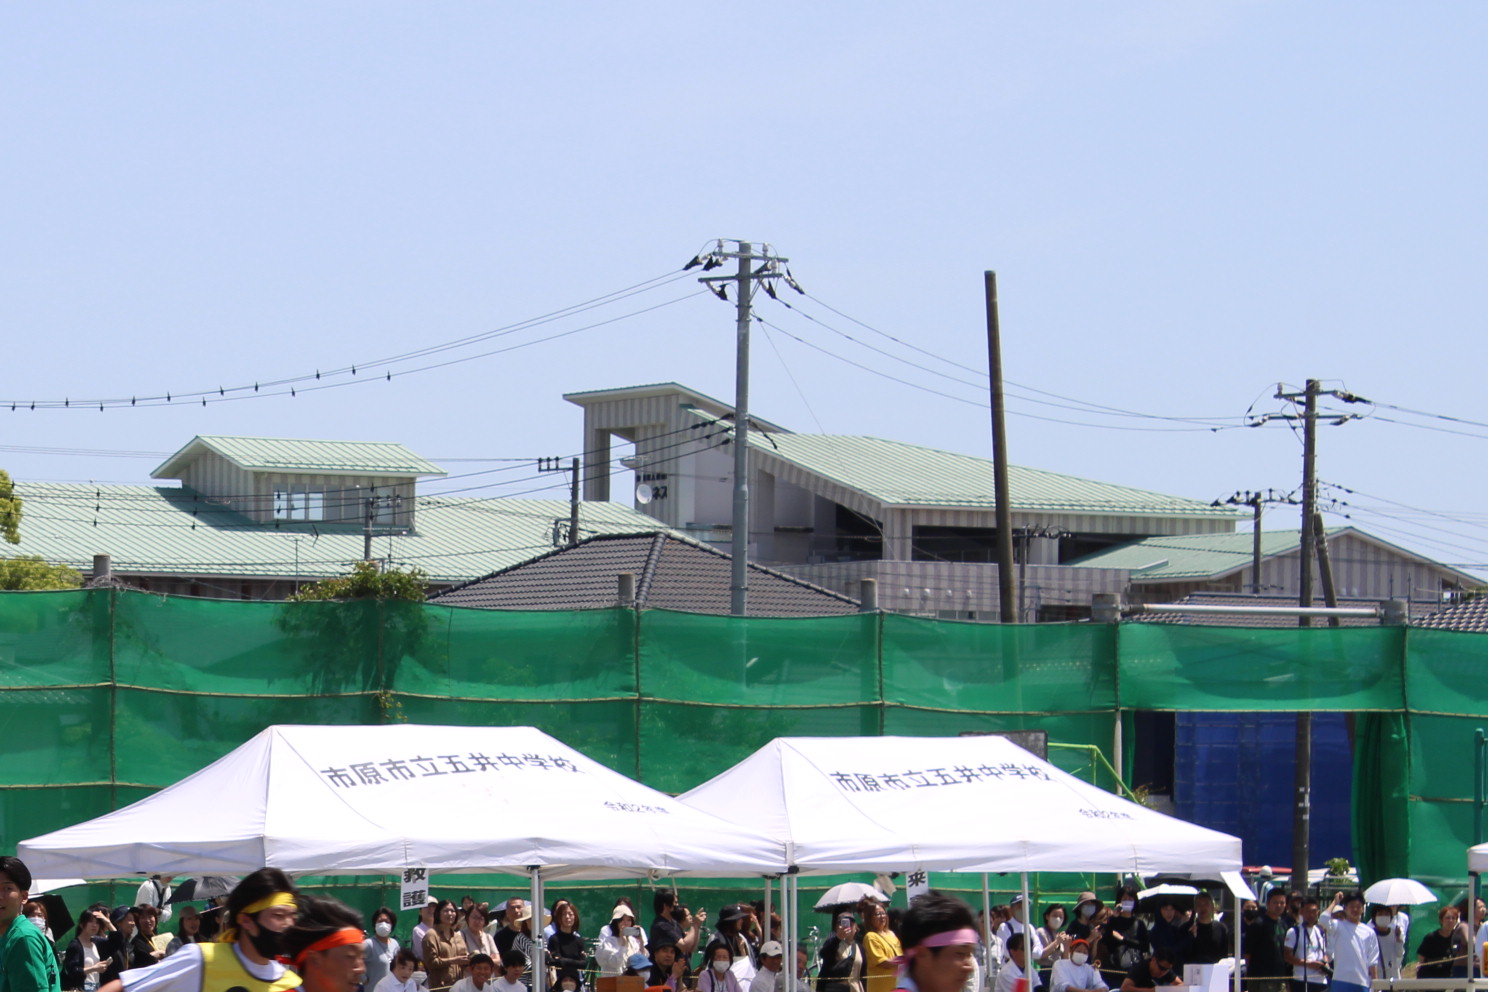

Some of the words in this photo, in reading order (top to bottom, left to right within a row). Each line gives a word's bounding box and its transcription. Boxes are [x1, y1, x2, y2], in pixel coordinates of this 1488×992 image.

[320, 752, 586, 789] 市原市立五井中学校
[830, 763, 1060, 792] 市原市立五井中学校
